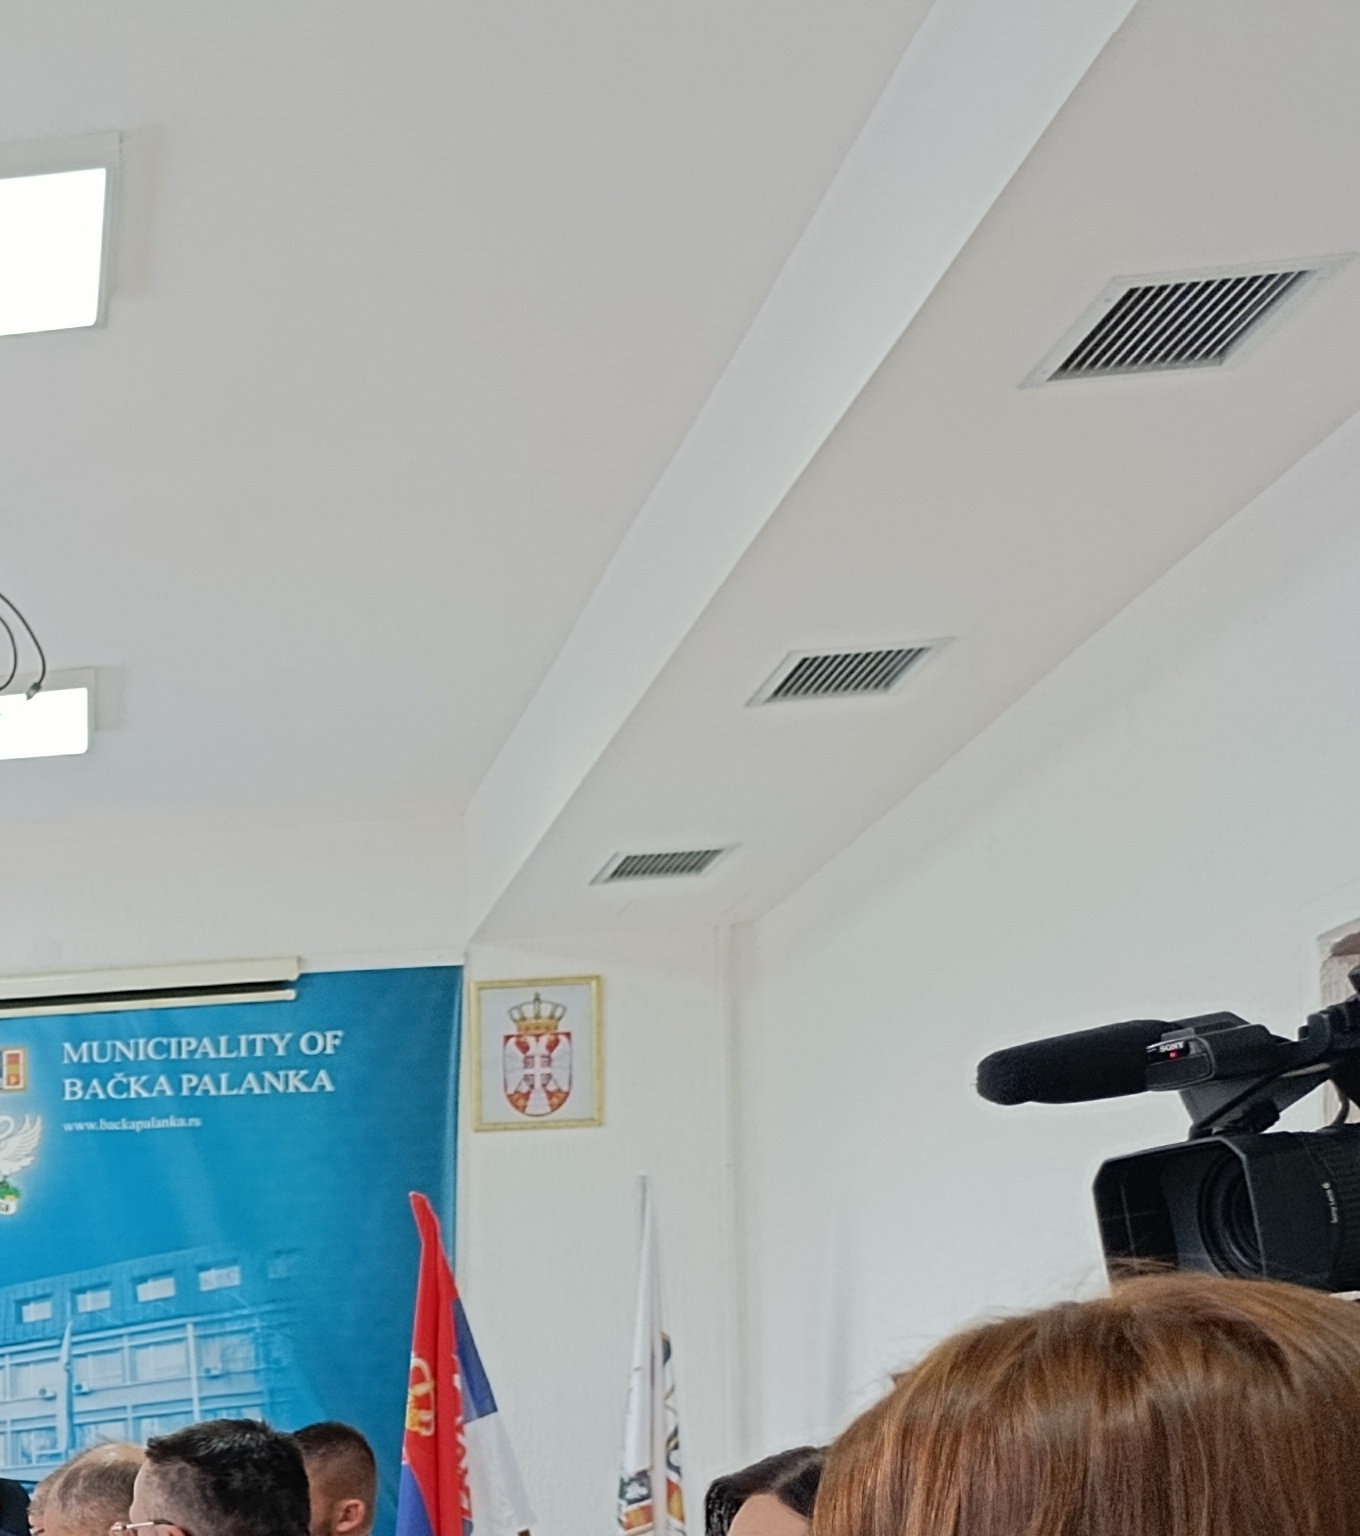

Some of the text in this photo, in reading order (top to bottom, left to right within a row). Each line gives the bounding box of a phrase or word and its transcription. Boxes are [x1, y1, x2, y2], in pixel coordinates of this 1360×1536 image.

[62, 1030, 345, 1064] MUNICIPALITY OF
[1159, 1040, 1185, 1053] SONY
[62, 1068, 336, 1101] BAČKA PALANKA
[62, 1115, 203, 1133] www.backapalanka.rs
